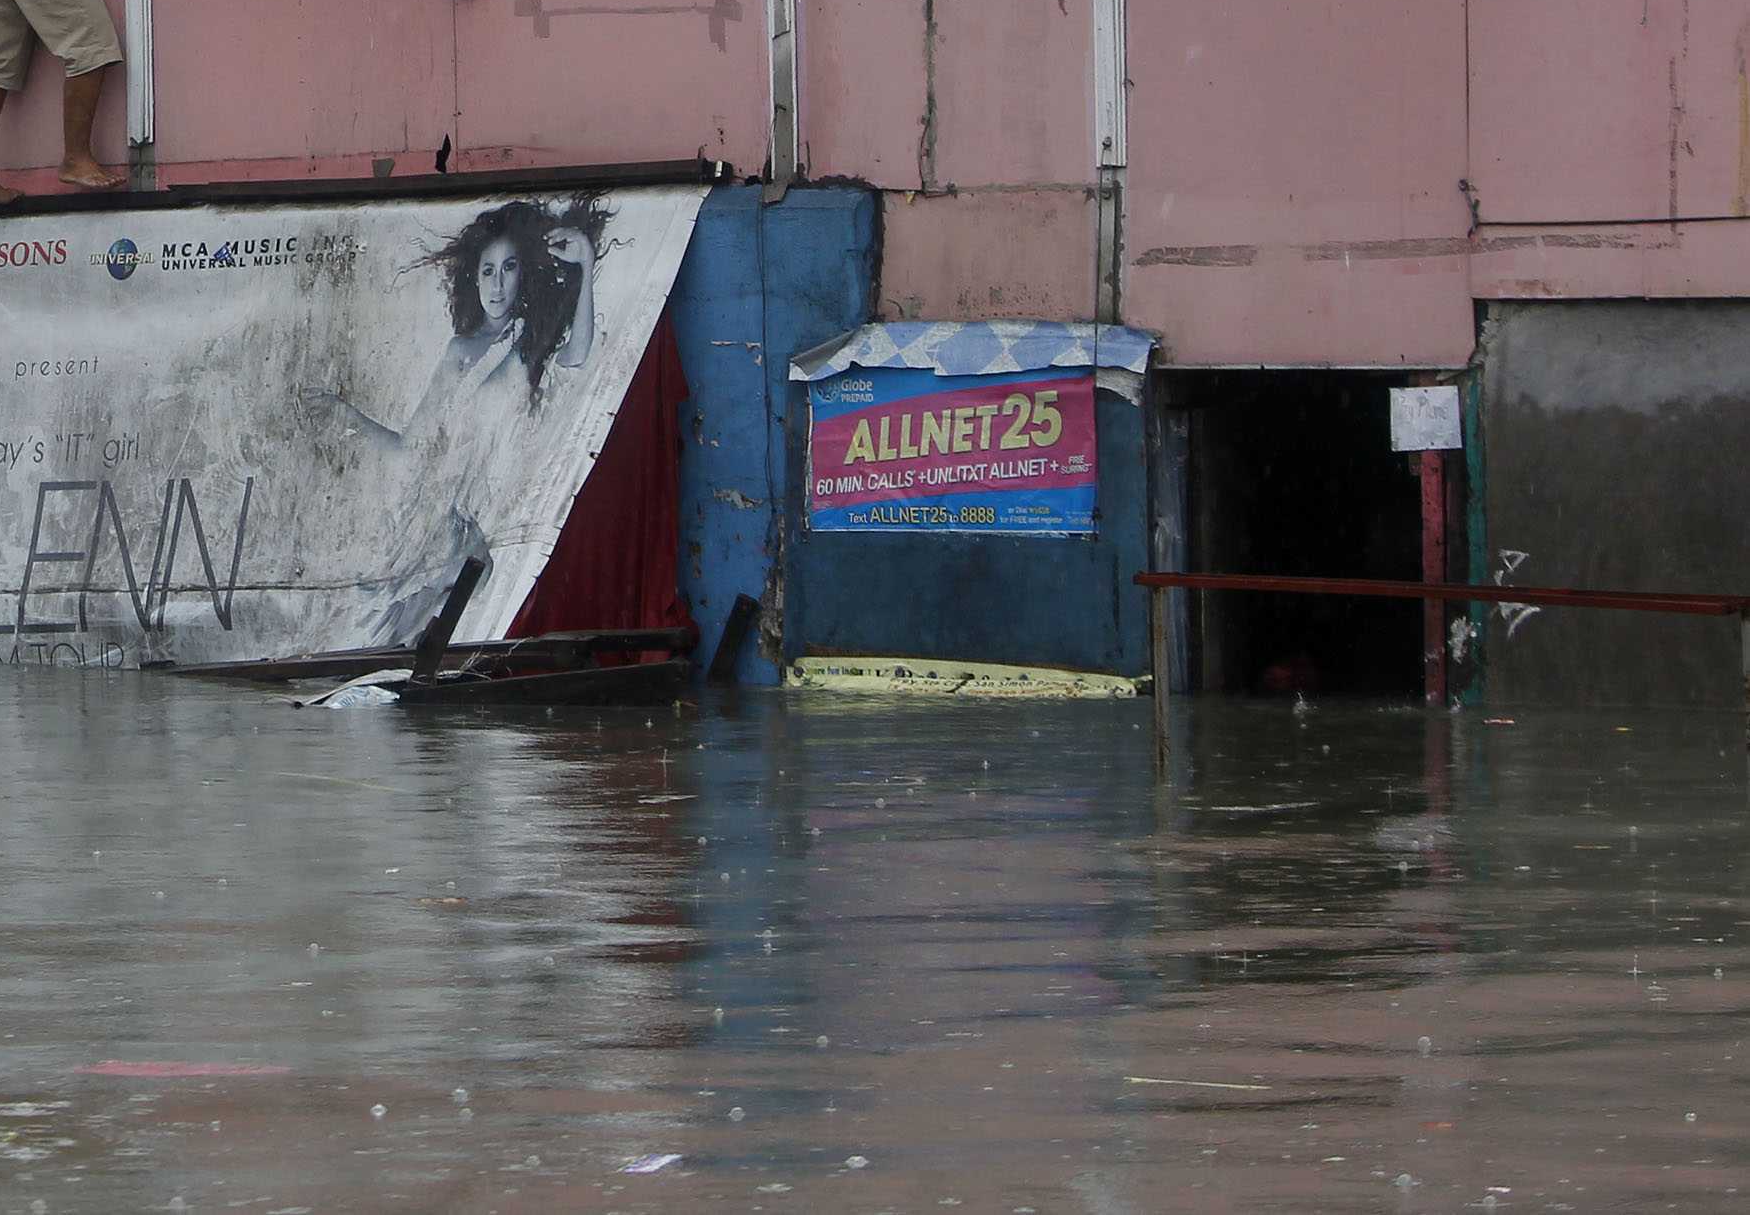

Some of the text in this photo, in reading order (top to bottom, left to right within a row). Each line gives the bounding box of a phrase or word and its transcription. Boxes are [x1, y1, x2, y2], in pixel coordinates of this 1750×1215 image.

[162, 242, 208, 258] MCA
[224, 237, 297, 256] MUSIC
[89, 252, 154, 266] UNIVERSAL
[161, 256, 246, 271] UNIVERSAL
[253, 254, 298, 267] MUSIC
[15, 356, 100, 381] present
[841, 379, 874, 392] Globe
[841, 393, 874, 403] PREPAID
[103, 433, 140, 468] girl
[817, 479, 834, 496] 60
[836, 476, 865, 494] MIN.
[989, 458, 1048, 480] ALLNET
[849, 512, 868, 524] Text
[870, 507, 947, 524] ALLNET25
[961, 507, 996, 524] 8888
